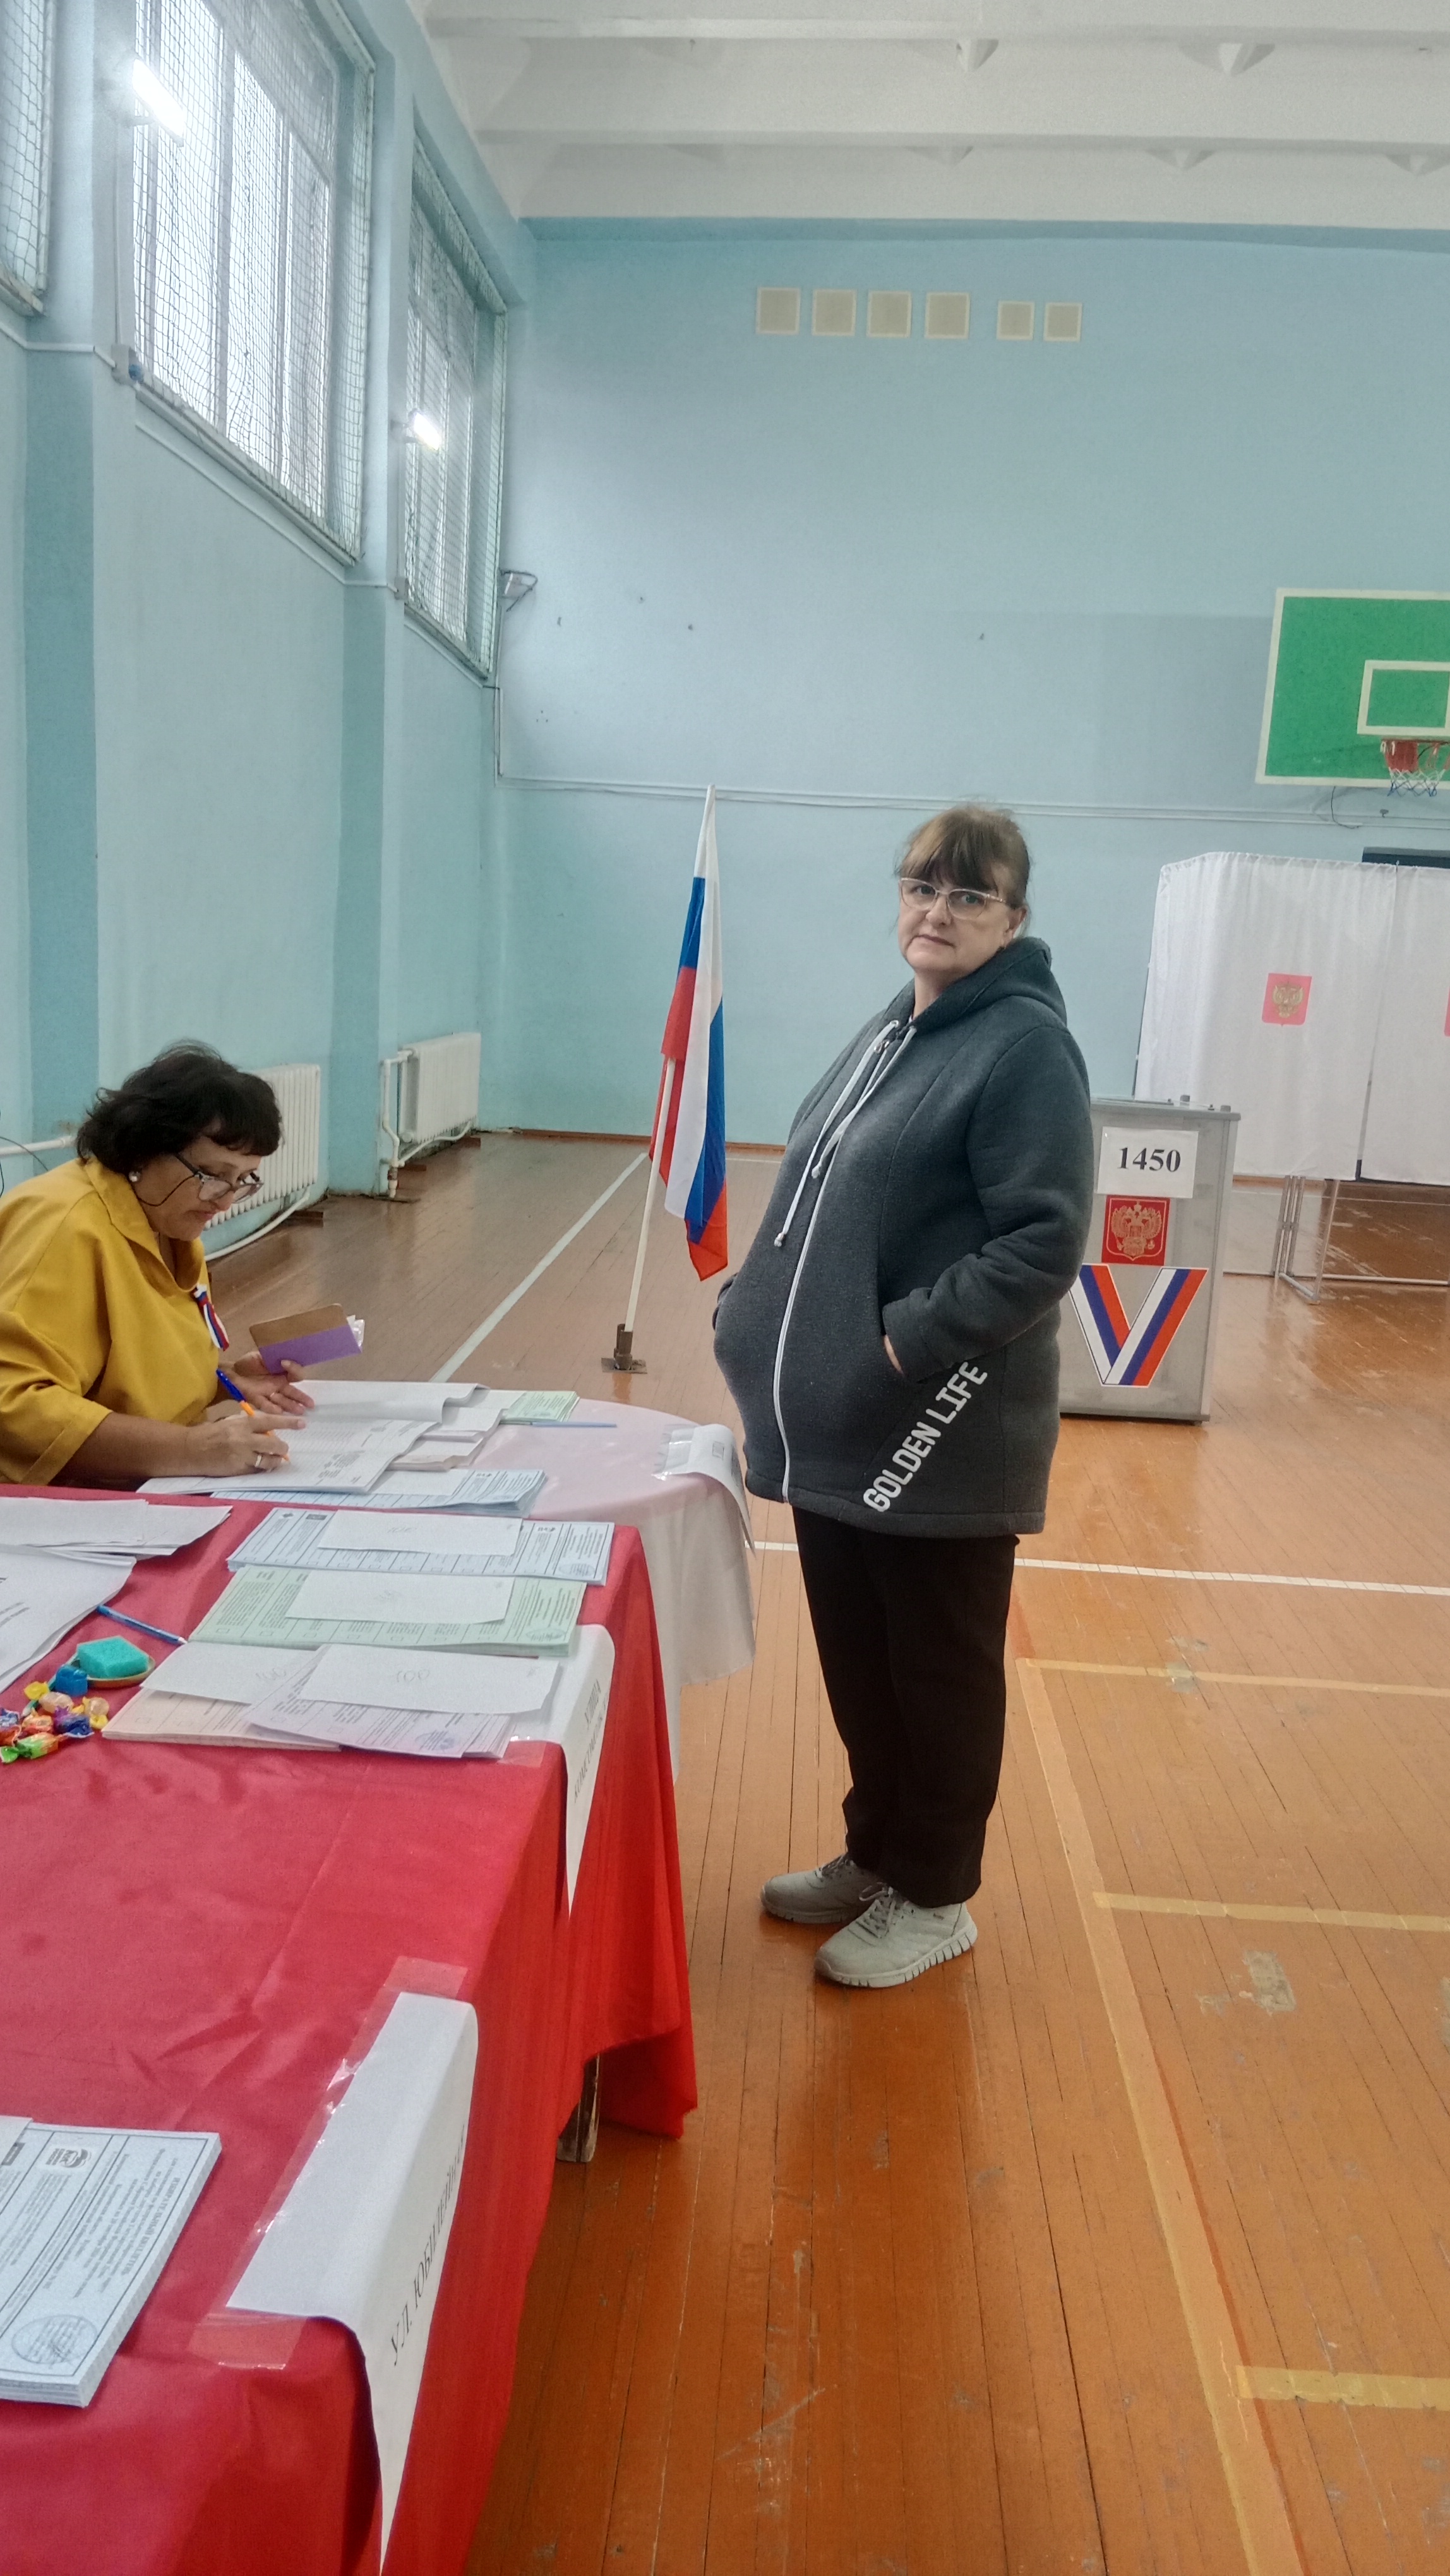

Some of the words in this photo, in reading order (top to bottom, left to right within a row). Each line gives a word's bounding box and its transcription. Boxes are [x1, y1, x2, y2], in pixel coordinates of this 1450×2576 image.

[1117, 1147, 1182, 1173] 1450
[863, 1421, 942, 1512] GOLDEN
[925, 1361, 988, 1424] LIFE
[390, 2301, 412, 2367] УЛ.
